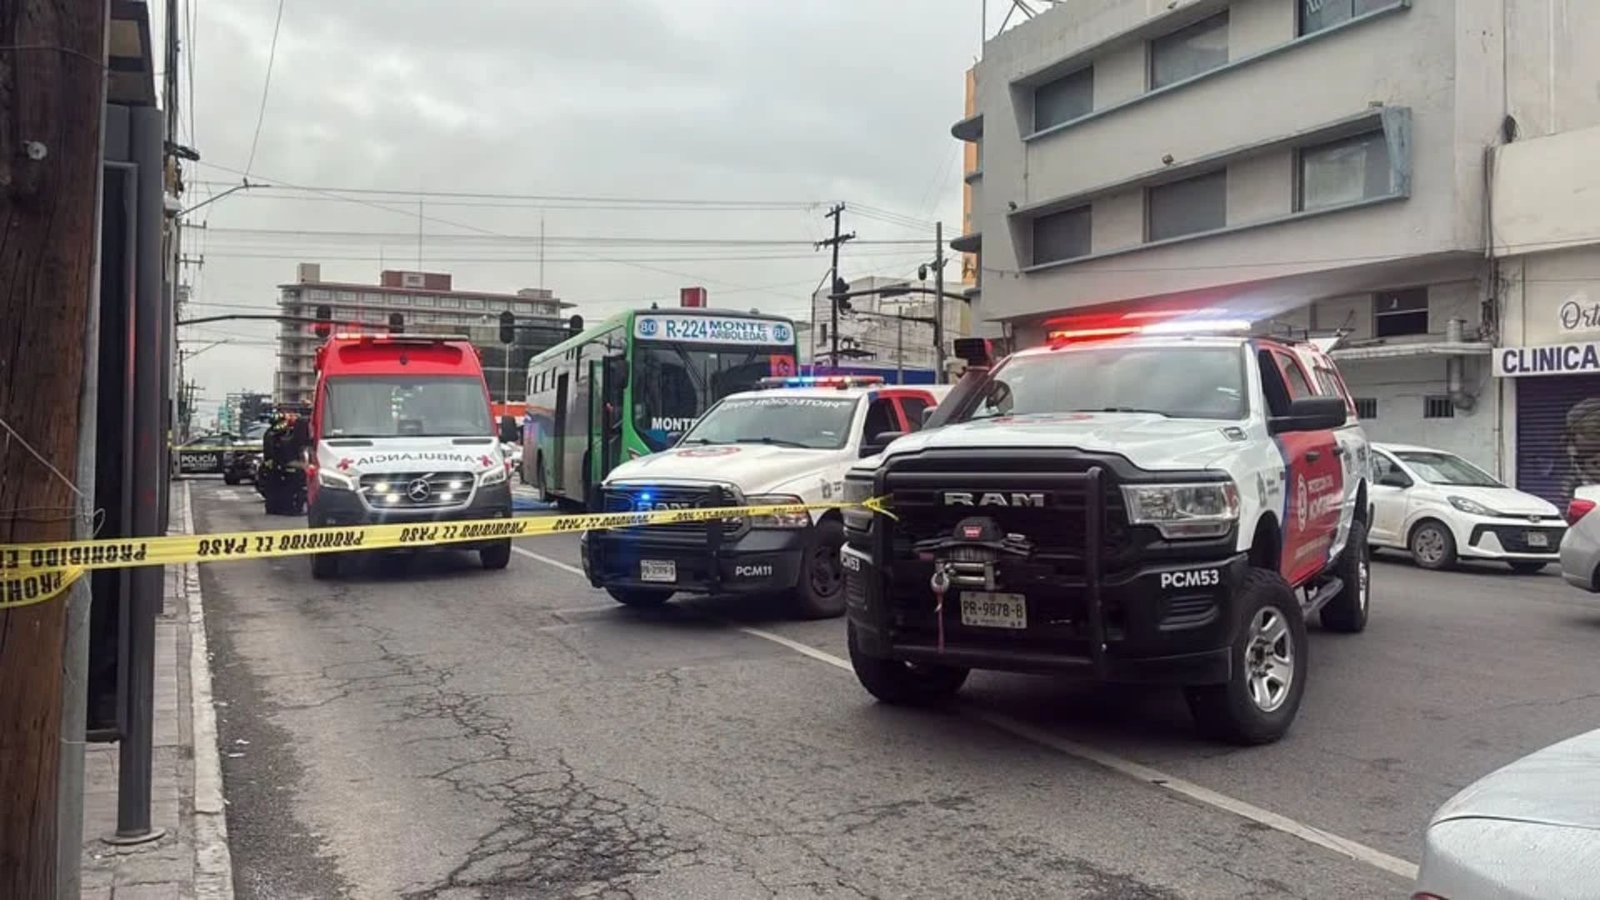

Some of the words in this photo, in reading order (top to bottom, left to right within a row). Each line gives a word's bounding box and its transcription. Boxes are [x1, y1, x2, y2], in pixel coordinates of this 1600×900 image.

[666, 320, 707, 338] R-224
[709, 321, 768, 333] MONTE
[710, 329, 768, 342] ARBOLEDAS
[1503, 345, 1600, 373] CLINICA
[943, 492, 1045, 507] RAM
[399, 527, 439, 542] PASO
[442, 527, 458, 539] EL
[459, 522, 527, 538] PROHIBIDO
[198, 537, 248, 556] PASO
[255, 537, 274, 552] EL
[279, 531, 364, 550] PROHIBIDO
[31, 543, 147, 567] PROHIBIDO
[735, 566, 773, 576] PCM11
[1161, 569, 1219, 588] PCM53
[963, 601, 1023, 618] PR-9878-B
